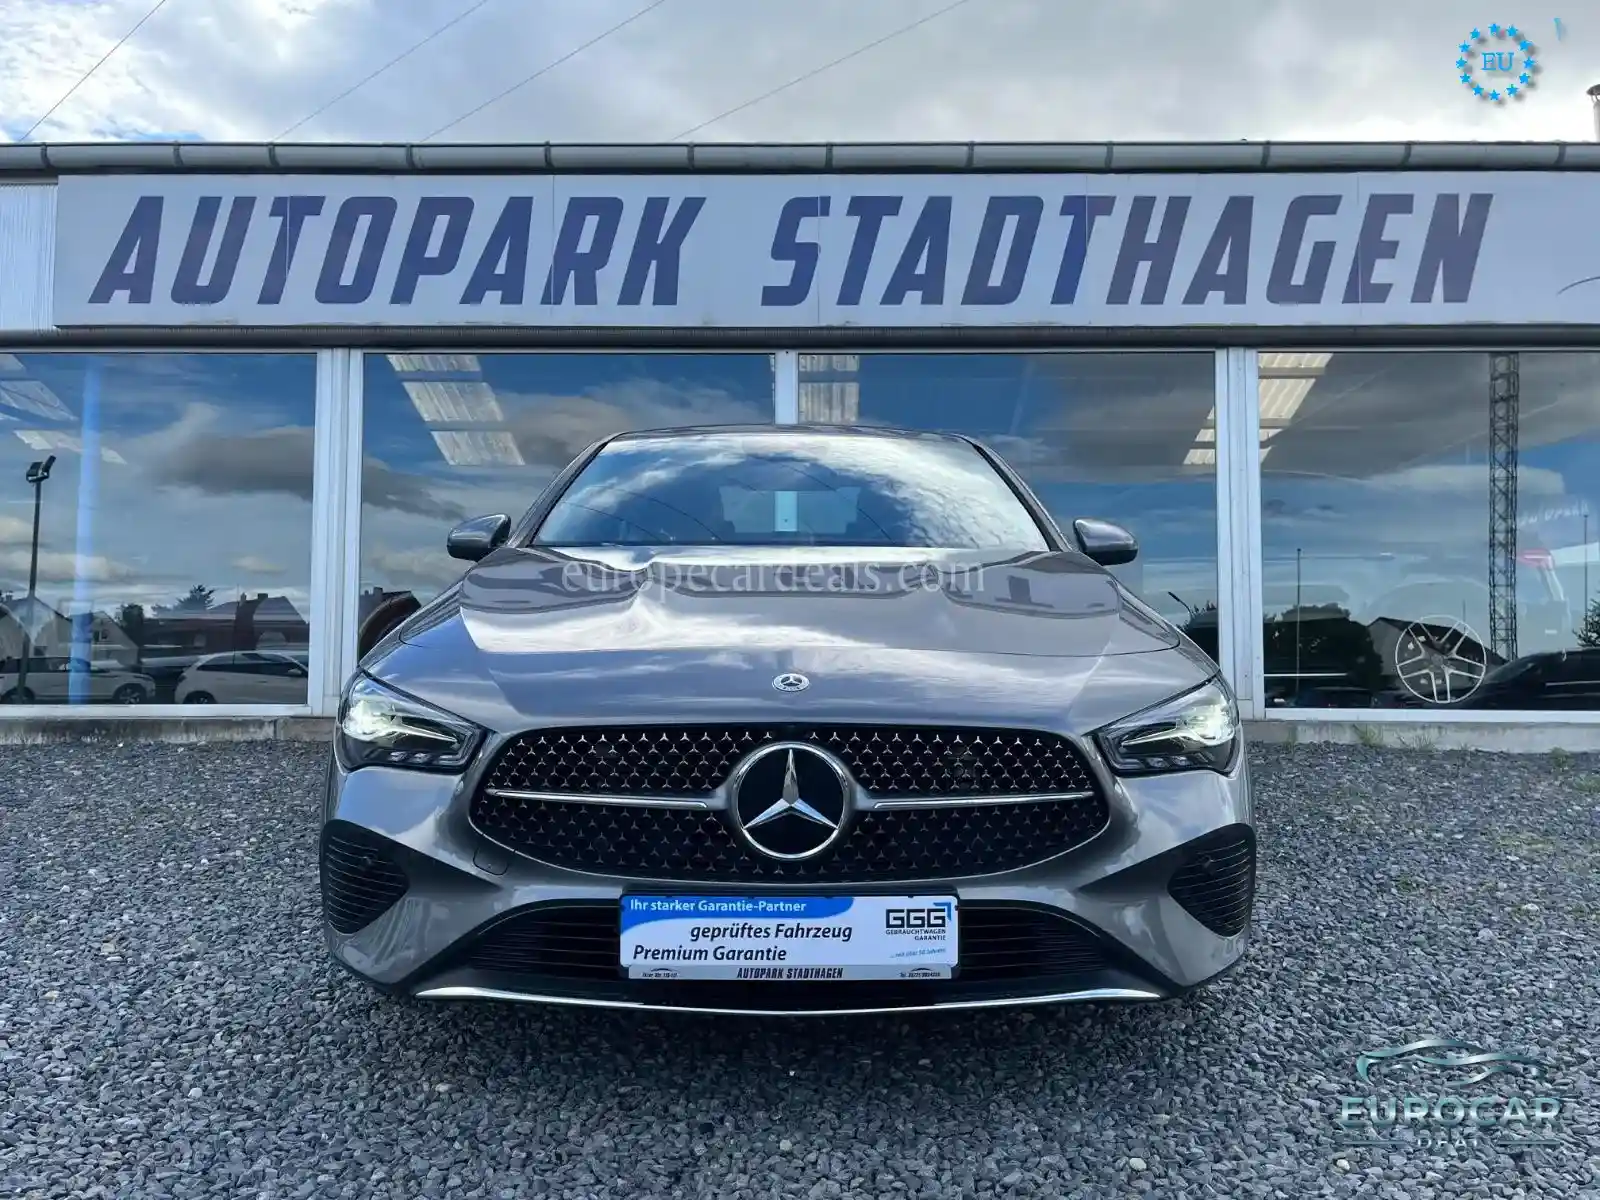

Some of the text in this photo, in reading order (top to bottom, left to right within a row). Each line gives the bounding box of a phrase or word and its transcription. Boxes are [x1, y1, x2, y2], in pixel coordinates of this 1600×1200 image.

[88, 193, 1494, 305] AUTOPARK STADTHAGEN
[630, 899, 807, 912] Ihr starker Garantie-Partner
[885, 908, 946, 929] GGG
[690, 923, 853, 942] geprüftes Fahrzeug
[633, 944, 787, 961] Premium Garantie
[737, 967, 844, 979] AUTOPARK STADTHAGEN
